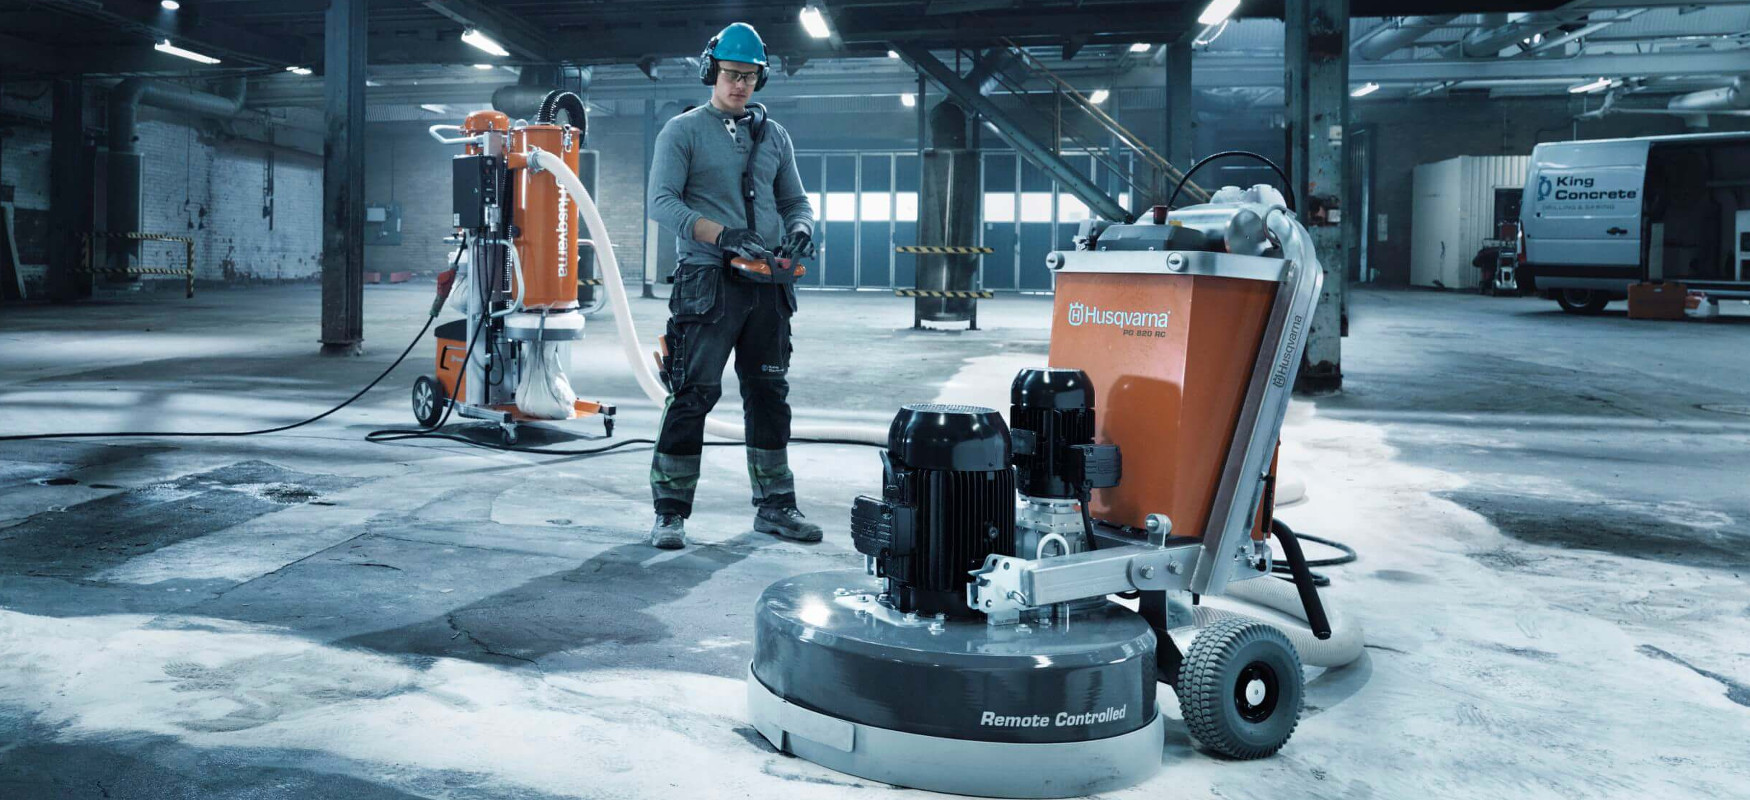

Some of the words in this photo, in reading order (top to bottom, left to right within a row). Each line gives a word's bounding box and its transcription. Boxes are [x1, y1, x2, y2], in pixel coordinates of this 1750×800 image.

[1557, 176, 1594, 187] King
[1555, 189, 1637, 200] Concrete
[1085, 306, 1168, 328] Husqvarna
[1136, 329, 1152, 337] 820
[1277, 315, 1302, 375] Husqvarna
[980, 711, 1050, 727] Remote
[1055, 704, 1127, 727] Controlled
